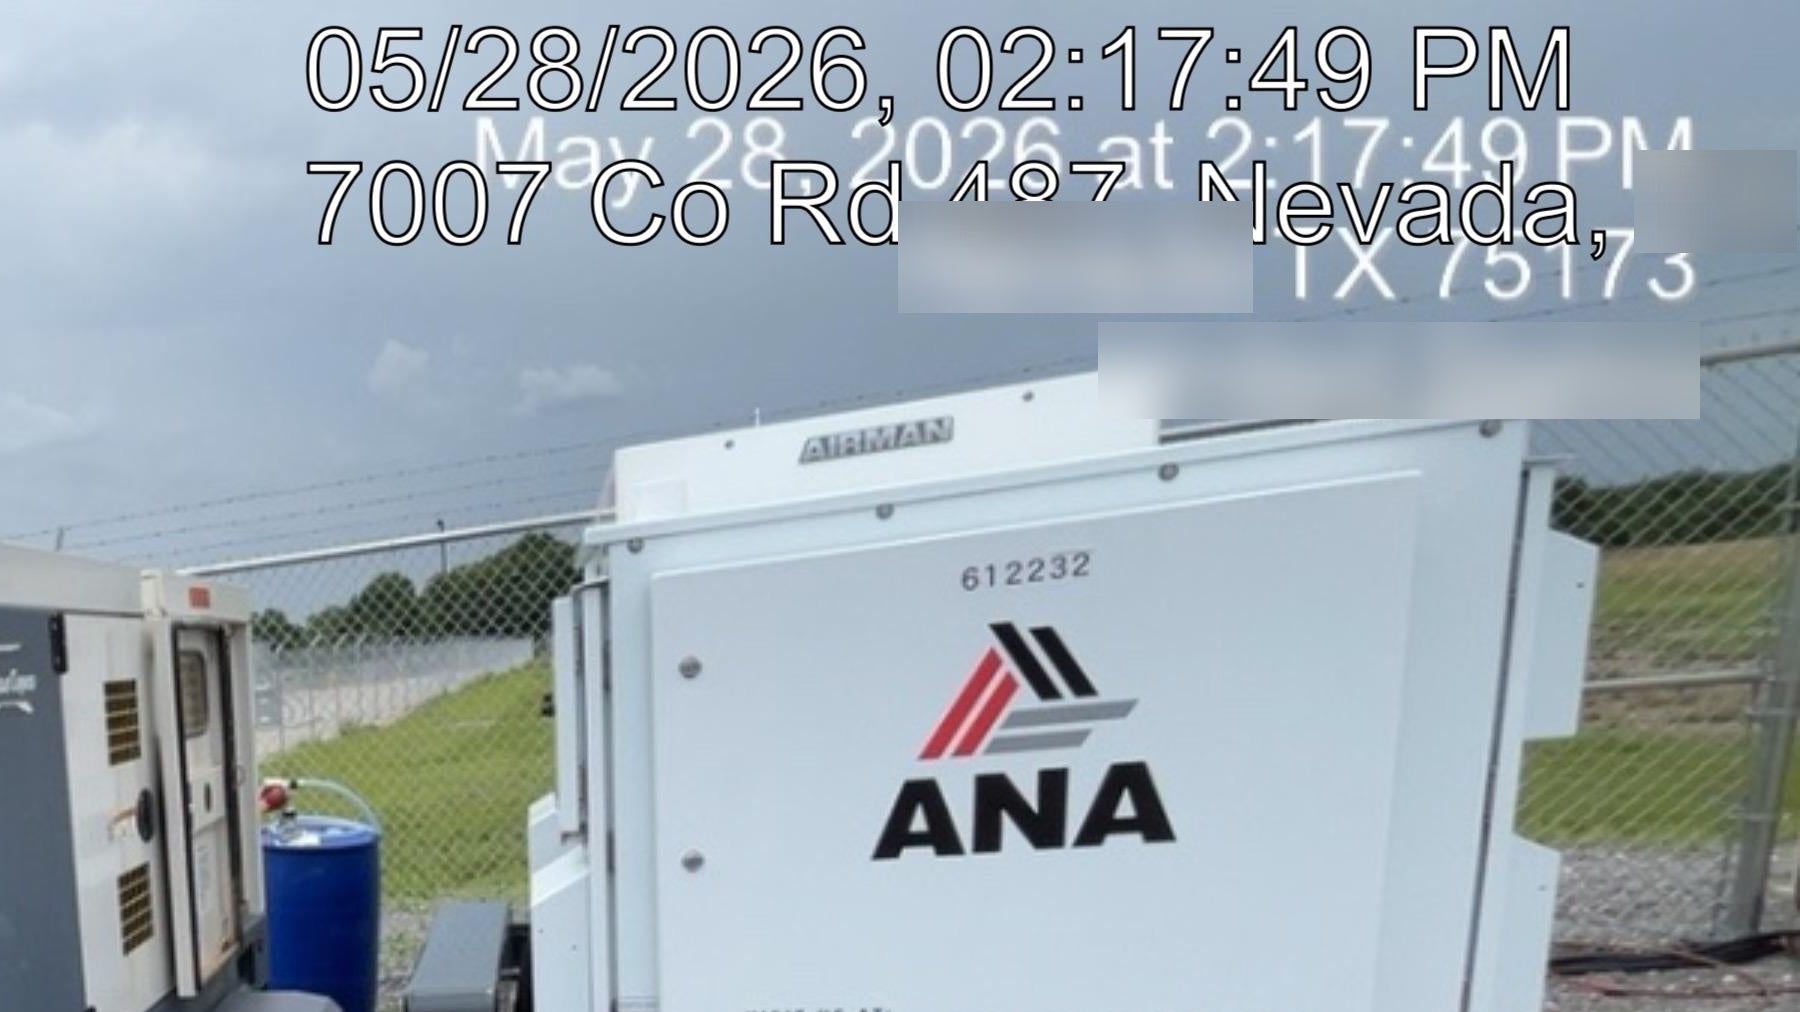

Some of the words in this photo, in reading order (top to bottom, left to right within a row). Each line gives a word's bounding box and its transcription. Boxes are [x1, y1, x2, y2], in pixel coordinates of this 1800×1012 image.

[798, 415, 954, 465] AIRMAN
[961, 551, 1091, 592] 612232
[871, 761, 1177, 860] ANA
